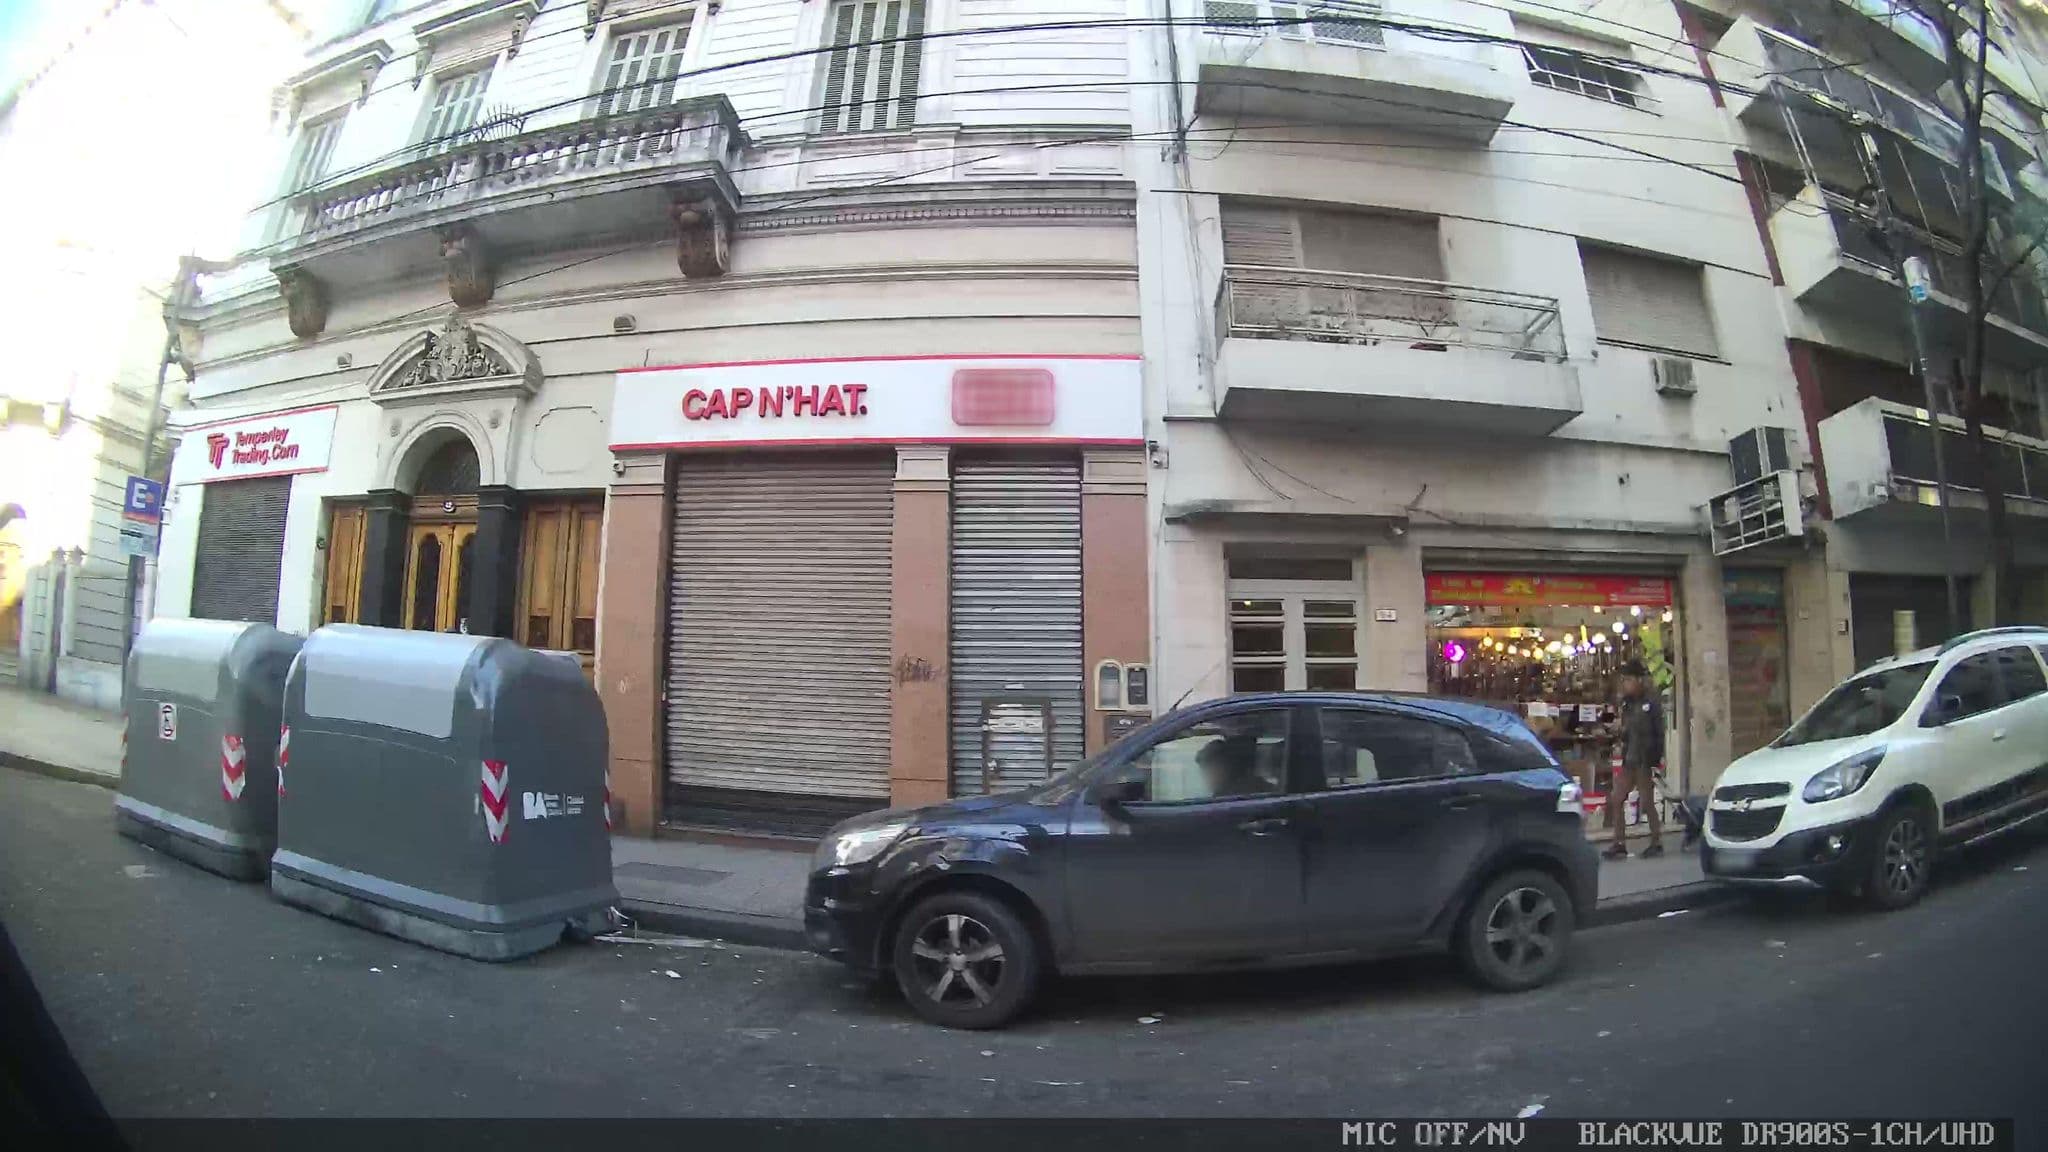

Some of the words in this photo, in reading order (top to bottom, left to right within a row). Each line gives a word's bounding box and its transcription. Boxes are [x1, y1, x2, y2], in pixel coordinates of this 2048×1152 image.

[681, 387, 753, 420] CAP
[758, 383, 869, 418] N'HAT.
[234, 426, 290, 447] Temperley
[132, 481, 148, 509] E
